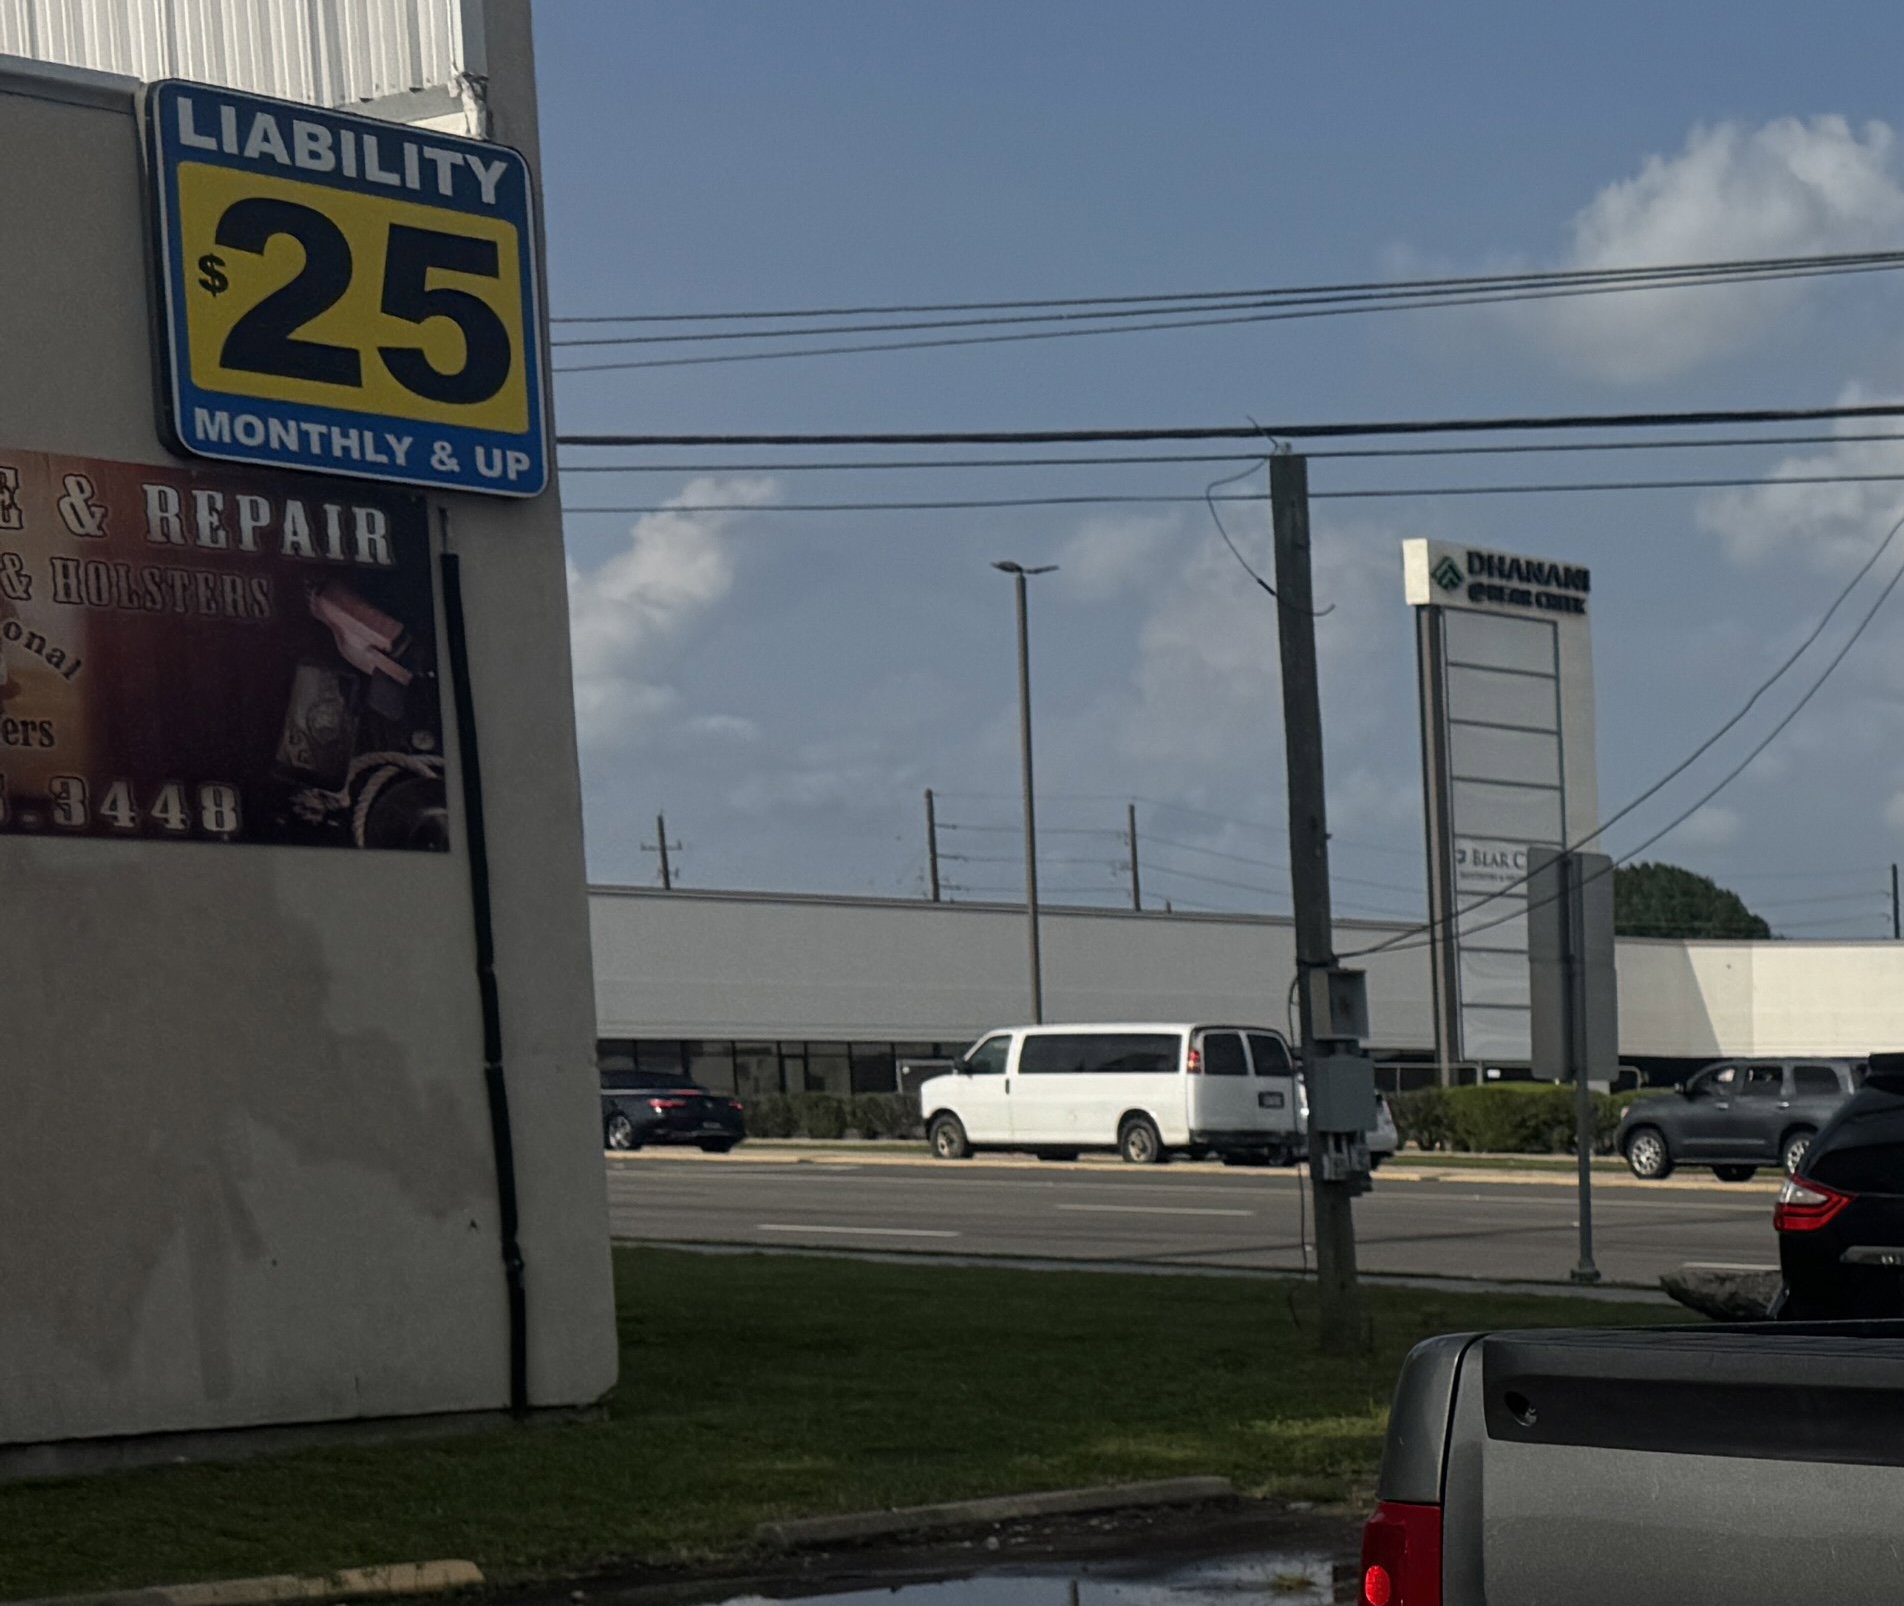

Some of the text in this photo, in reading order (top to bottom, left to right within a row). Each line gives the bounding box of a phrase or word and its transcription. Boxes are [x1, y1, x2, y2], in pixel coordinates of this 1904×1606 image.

[177, 97, 508, 204] LIABILITY
[194, 407, 530, 481] MONTHLY & UP
[57, 473, 107, 538] &
[142, 483, 393, 566] REPAIR
[0, 552, 272, 619] & HOLSTERS
[1466, 551, 1591, 592] DHANANI
